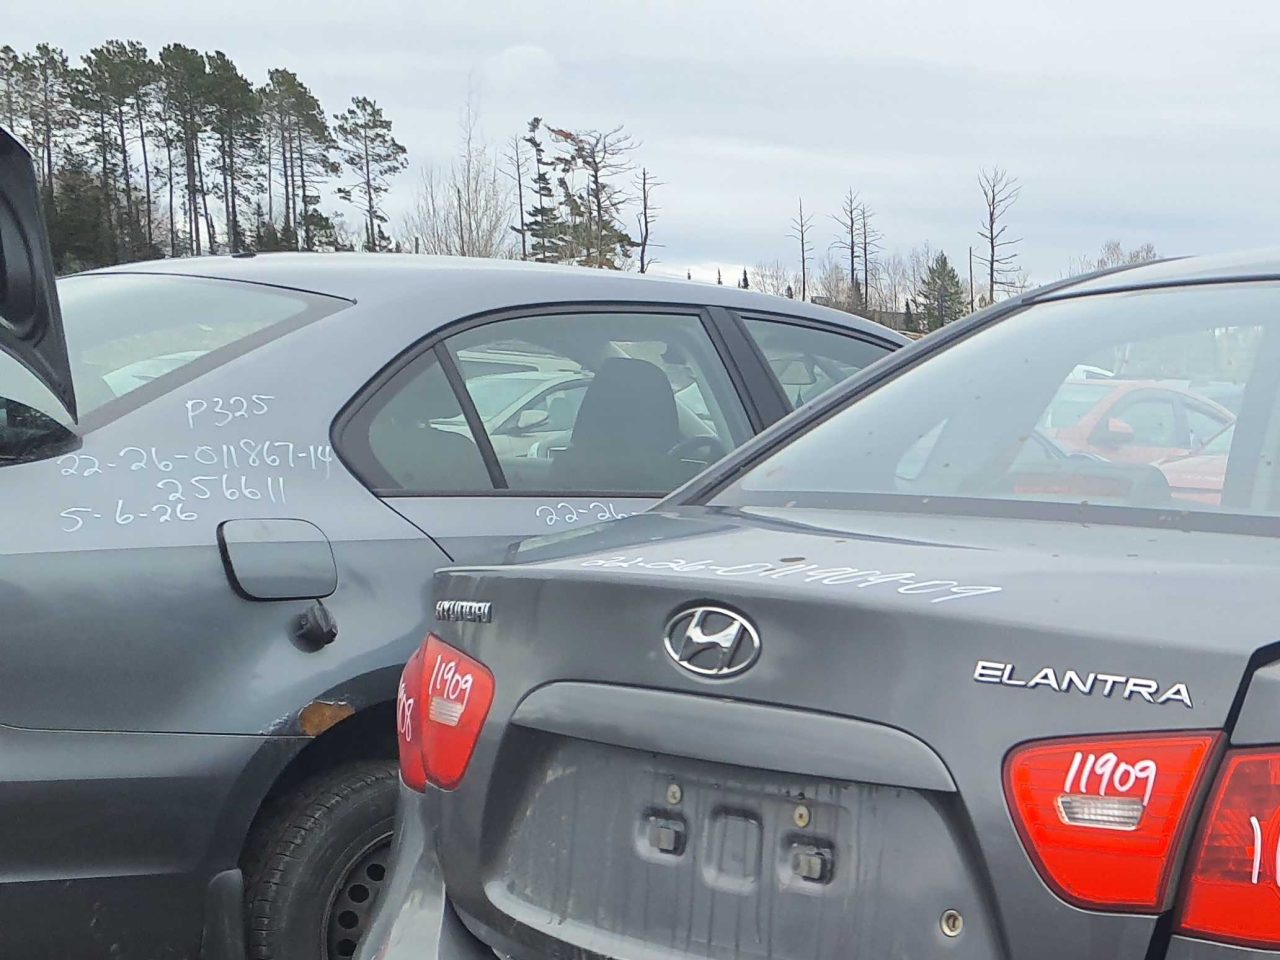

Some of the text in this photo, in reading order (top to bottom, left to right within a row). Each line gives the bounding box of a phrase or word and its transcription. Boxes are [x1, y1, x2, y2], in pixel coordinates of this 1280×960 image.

[185, 394, 275, 428] P325
[57, 439, 332, 479] 22-26-011867-14
[157, 474, 286, 504] 256611
[429, 655, 473, 713] 11909
[973, 660, 1193, 709] ELANTRA
[1063, 751, 1157, 806] 11909
